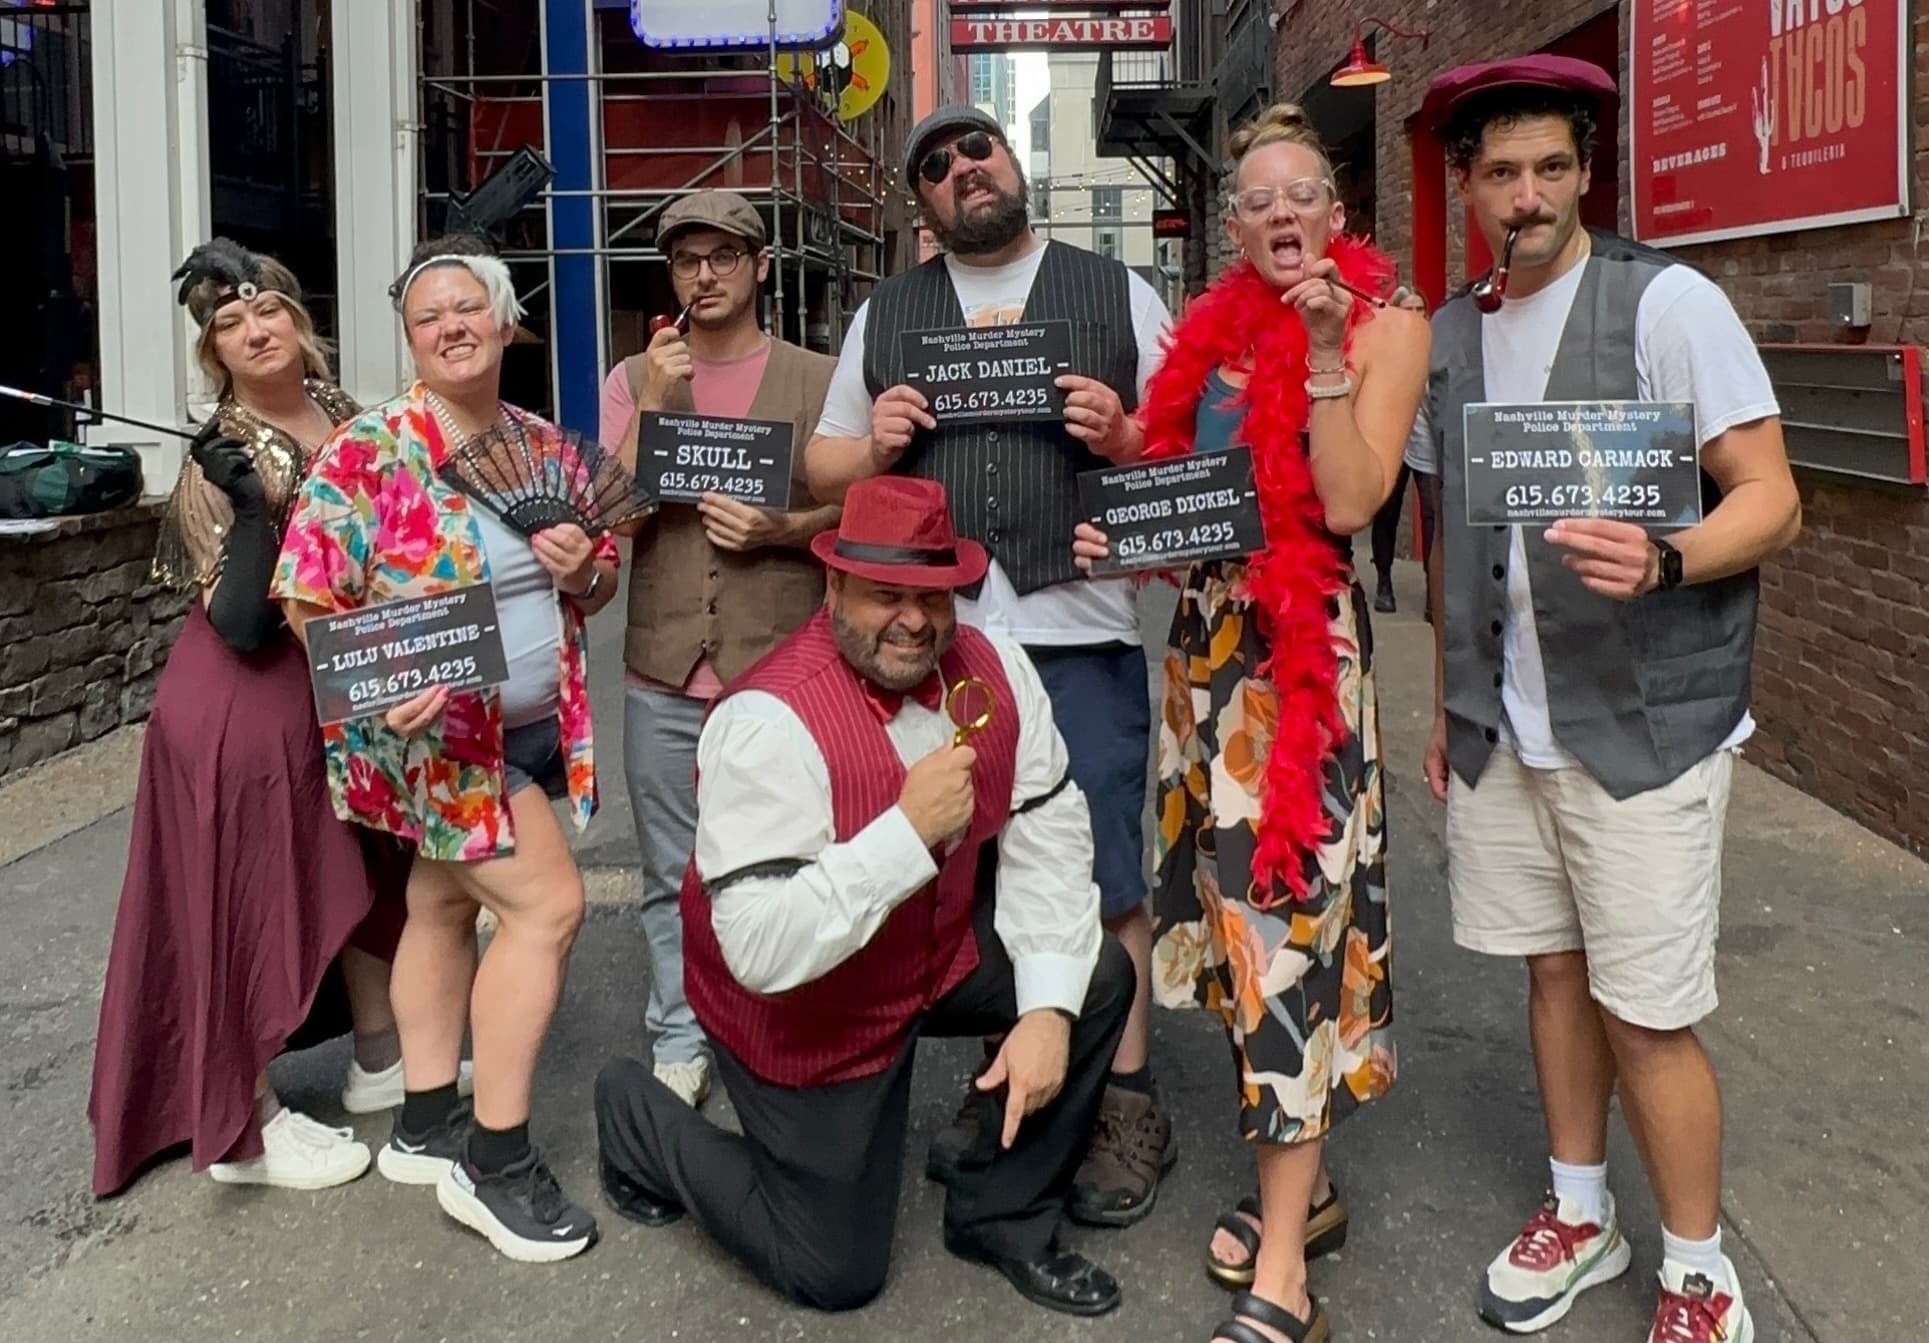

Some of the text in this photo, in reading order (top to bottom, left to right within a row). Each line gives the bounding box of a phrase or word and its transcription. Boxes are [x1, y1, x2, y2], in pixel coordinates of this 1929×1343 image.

[968, 19, 1155, 43] THEATRE
[1769, 5, 1866, 147] TACOS
[1653, 142, 1727, 174] BEVERAGES
[922, 327, 1046, 345] Nashville Murder Mystery
[944, 338, 1029, 352] Police Department
[926, 362, 972, 382] JACK
[977, 357, 1051, 379] DANIEL
[935, 388, 1048, 412] 615.673.4235
[658, 417, 772, 436] Nashville Murder Mystery
[1494, 410, 1661, 423] Nashville Murder Mystery
[1523, 422, 1637, 434] Police Department
[677, 427, 755, 441] Police Department
[676, 445, 752, 470] SKULL
[1491, 451, 1572, 469] EDWARD
[1579, 450, 1673, 468] CARMACK
[1101, 455, 1228, 486] Nashville Murder Mystery
[1124, 468, 1211, 492] Police Department
[659, 472, 764, 495] 615.673.4235
[1106, 500, 1172, 525] GEORGE
[1176, 488, 1240, 514] DICKEL
[1505, 485, 1661, 507] 615.673.4235
[1118, 521, 1234, 557] 615.673.4235
[328, 593, 467, 632] Nashville Murder Mystery
[354, 609, 450, 636] Police Department
[332, 647, 378, 672] LULU
[382, 624, 480, 660] VALENTINE
[349, 656, 476, 702] 615.673.4235
